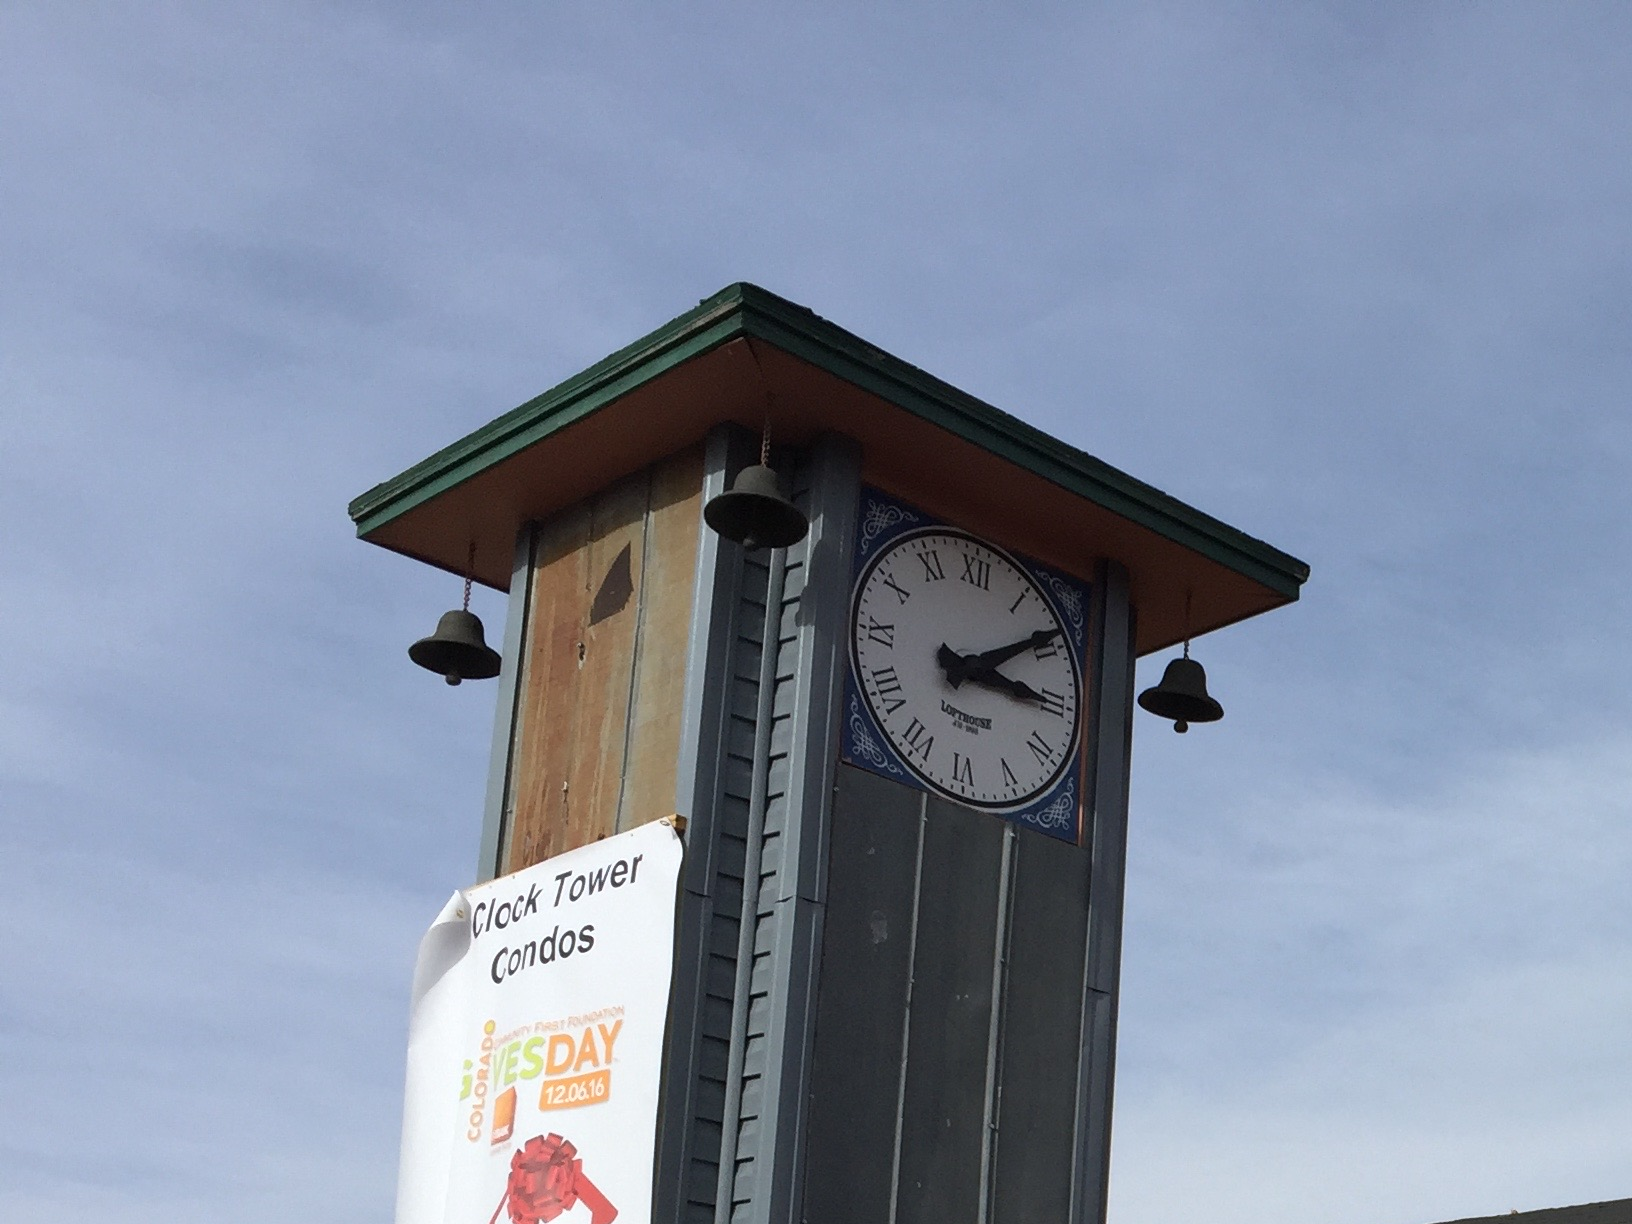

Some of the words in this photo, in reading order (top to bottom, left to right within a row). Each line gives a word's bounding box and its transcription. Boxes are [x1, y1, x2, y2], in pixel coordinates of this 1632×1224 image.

[473, 883, 542, 938] Clock
[553, 854, 643, 907] Tower
[491, 924, 595, 984] Condos
[546, 1077, 605, 1104] 12.06.16
